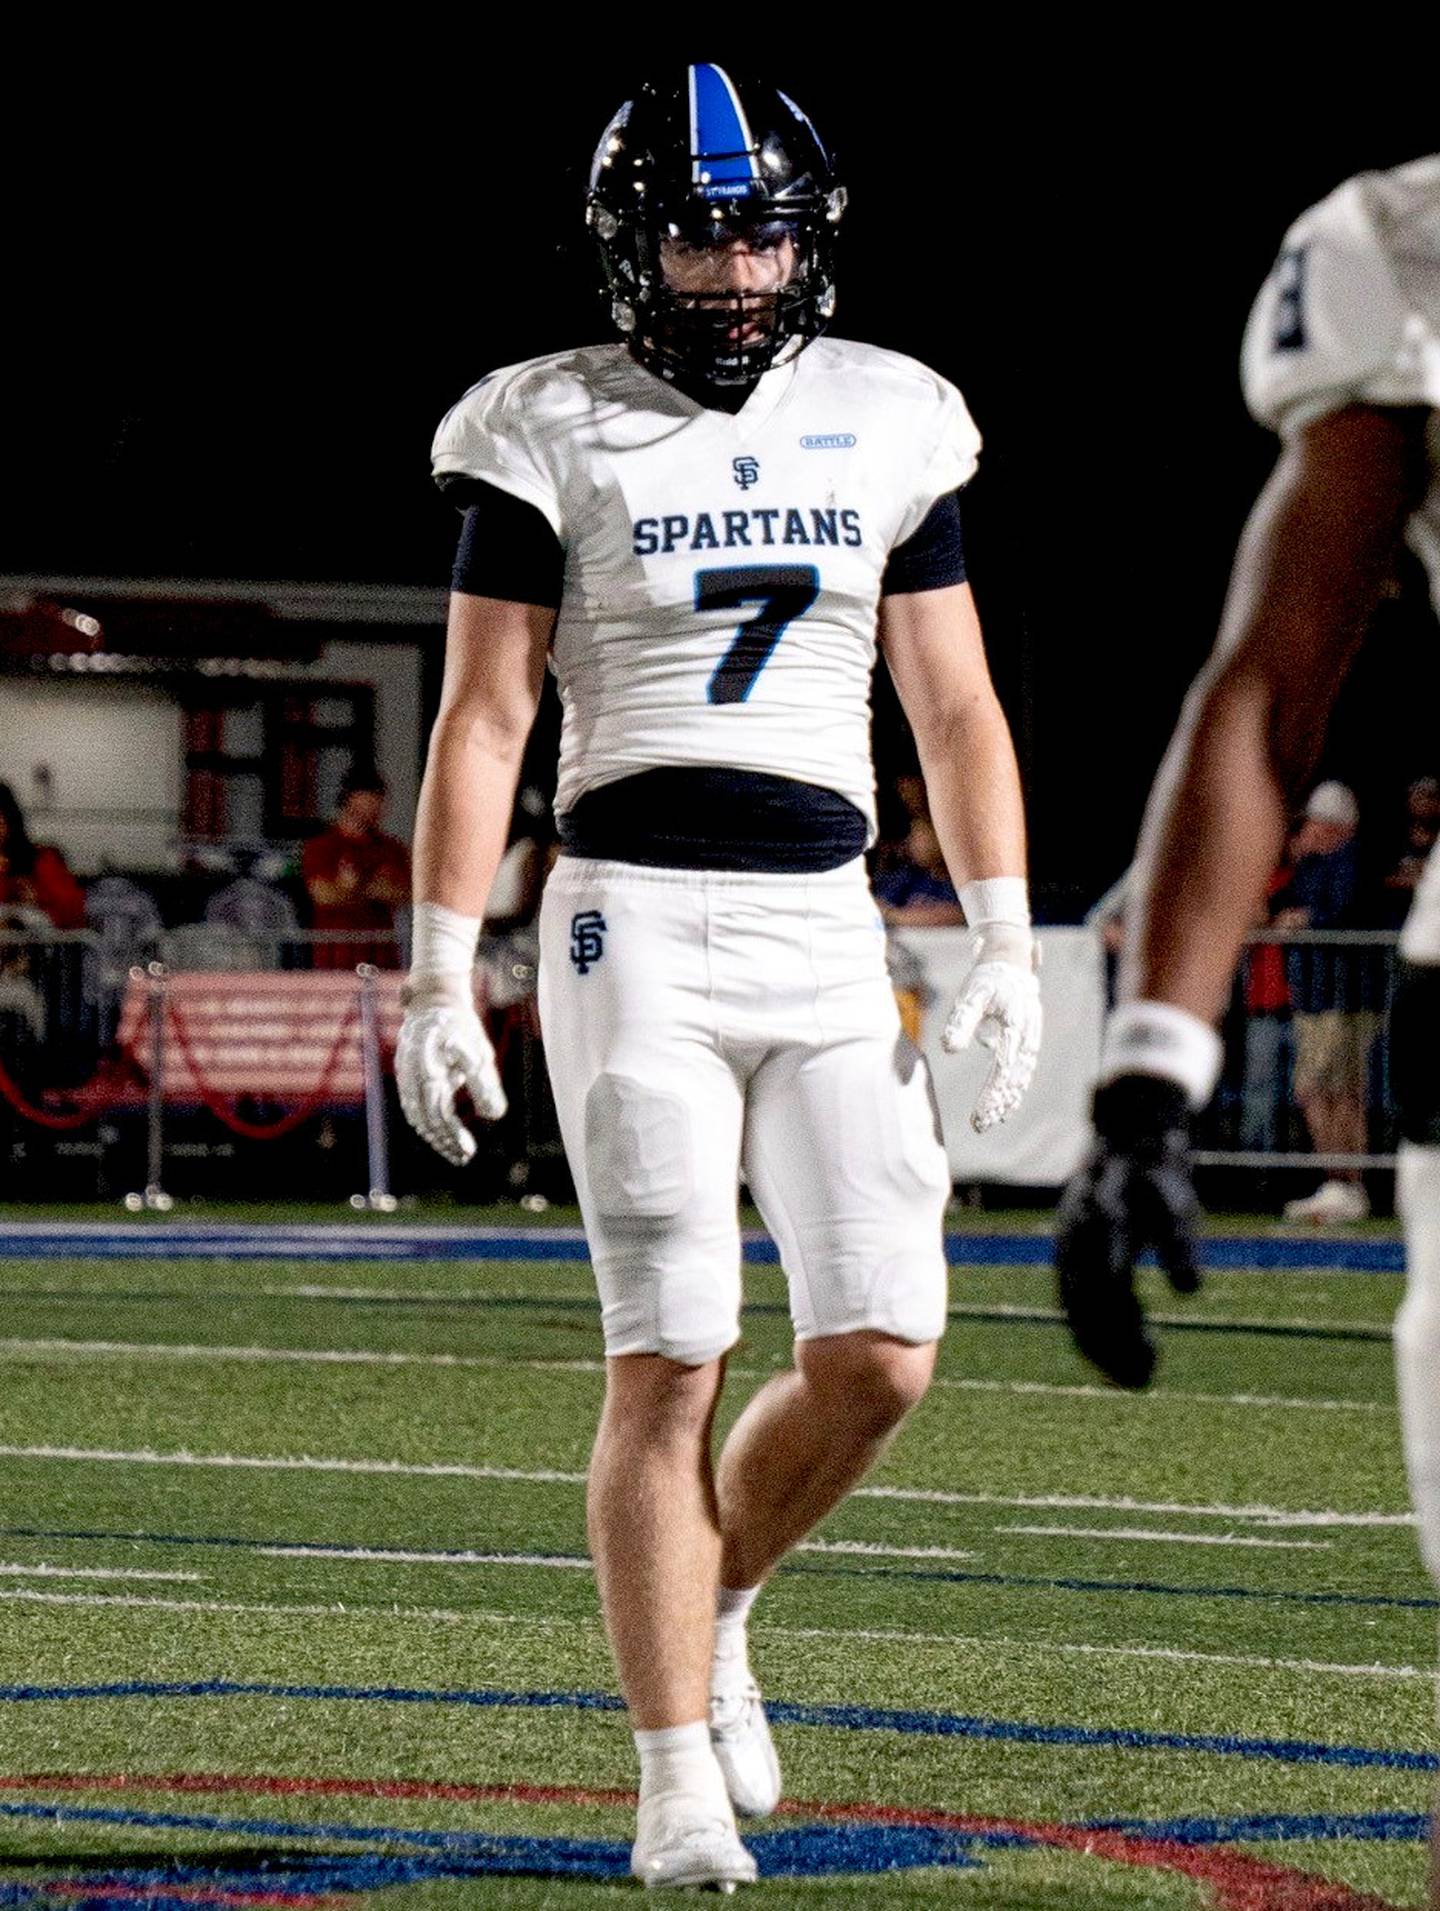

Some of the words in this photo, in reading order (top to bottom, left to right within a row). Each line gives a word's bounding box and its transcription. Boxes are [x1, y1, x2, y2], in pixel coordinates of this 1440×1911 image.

[804, 434, 852, 449] BATTLE
[632, 508, 863, 556] SPARTANS
[693, 563, 820, 705] 7
